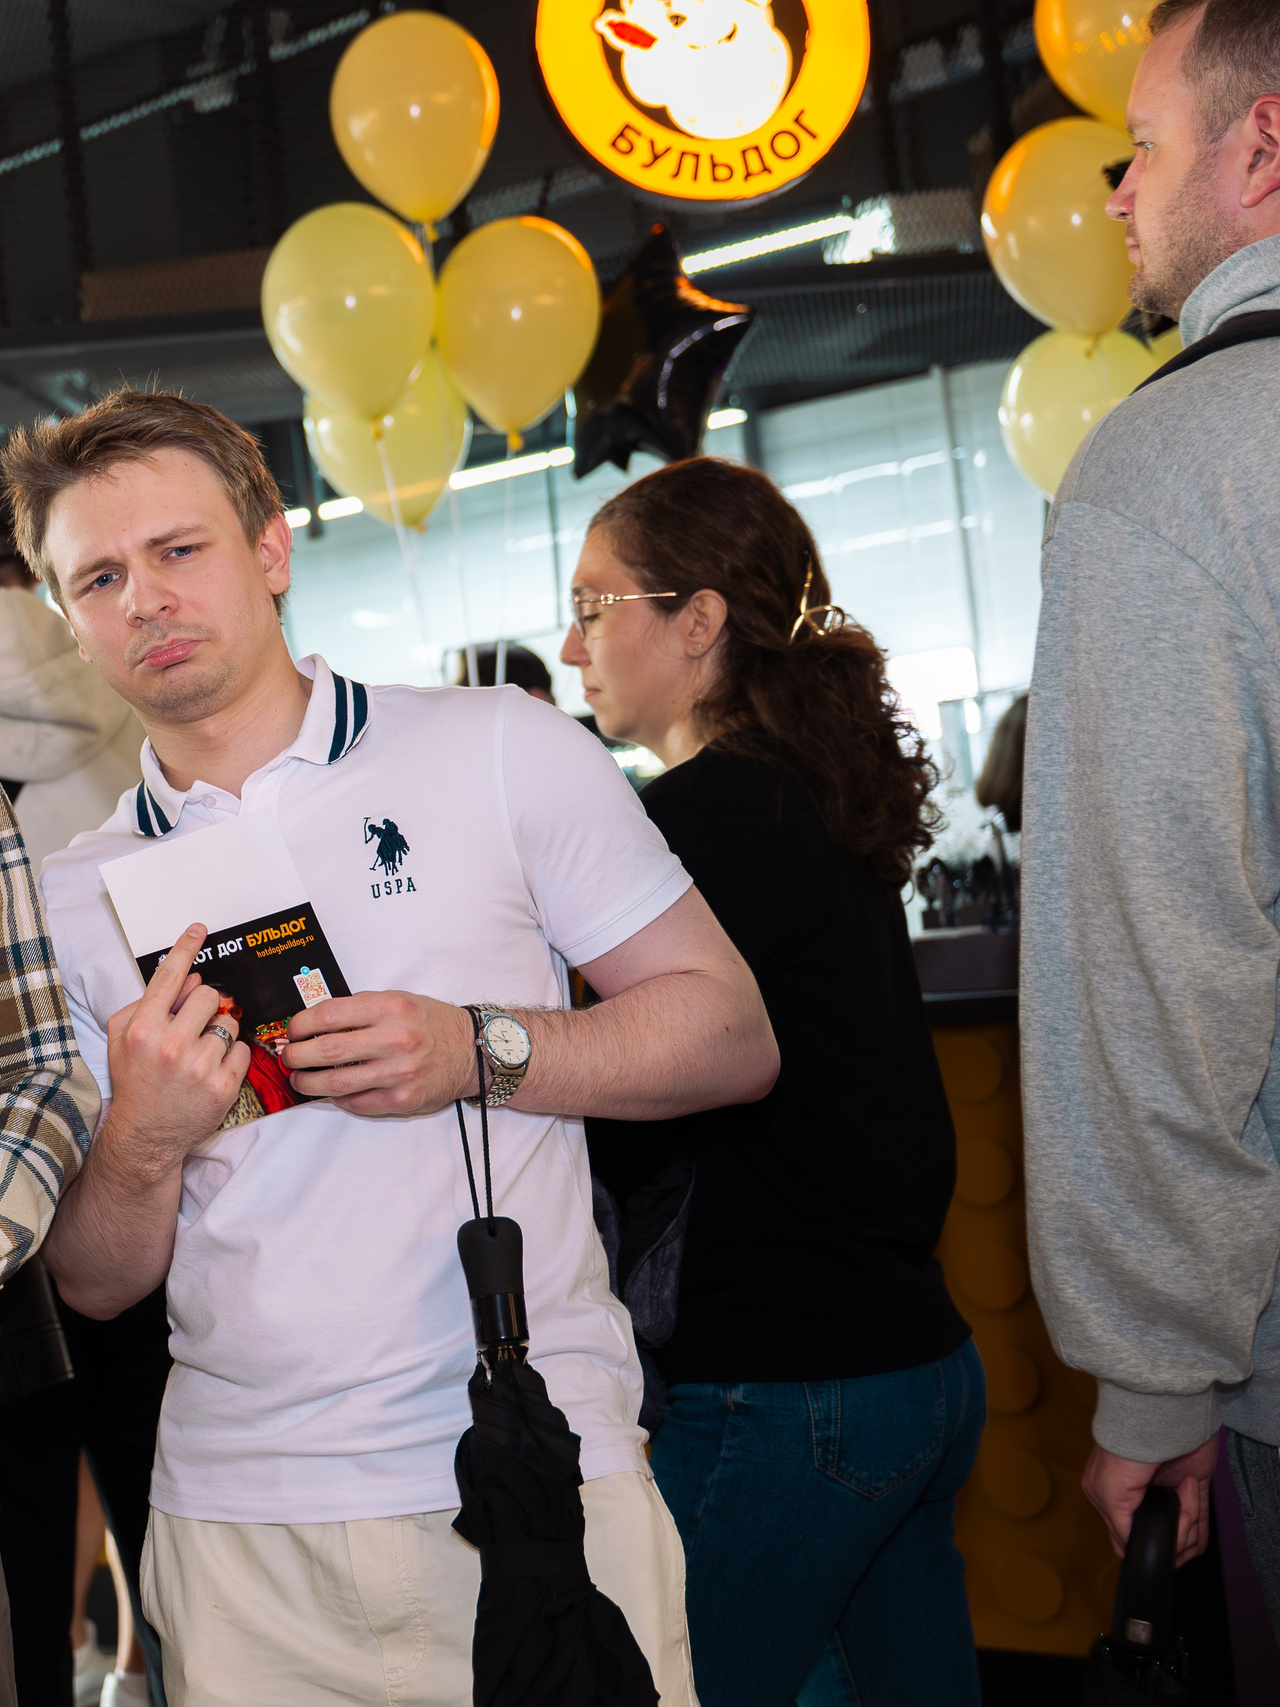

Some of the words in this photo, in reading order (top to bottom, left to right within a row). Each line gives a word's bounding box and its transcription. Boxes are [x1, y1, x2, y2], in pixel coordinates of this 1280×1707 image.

[609, 107, 819, 183] БУЛЬДОГ
[371, 876, 417, 899] USPA
[193, 947, 214, 965] ОТ
[217, 937, 243, 958] ДОГ
[245, 917, 306, 947] БУЛЬДОГ
[256, 934, 314, 958] hotdogbulldog.ru
